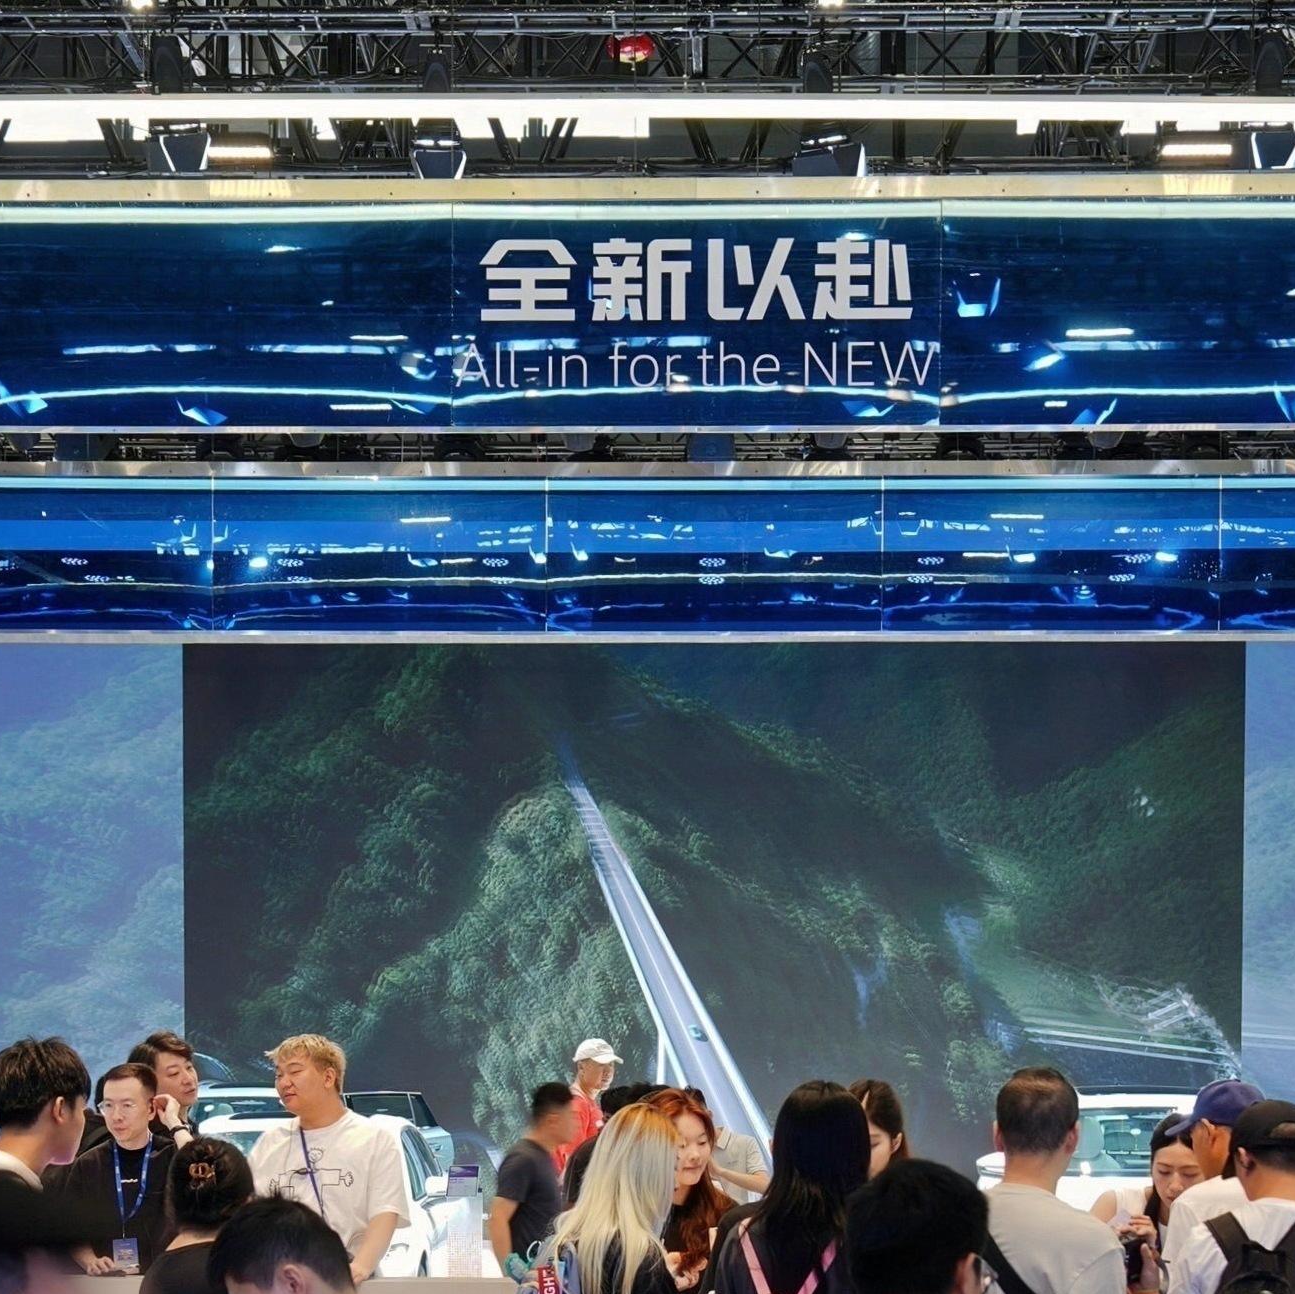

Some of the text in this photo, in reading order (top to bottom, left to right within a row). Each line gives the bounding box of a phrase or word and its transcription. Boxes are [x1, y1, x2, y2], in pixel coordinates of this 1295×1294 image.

[479, 237, 914, 322] 全新以赴
[454, 341, 938, 389] All-in for the NEW
